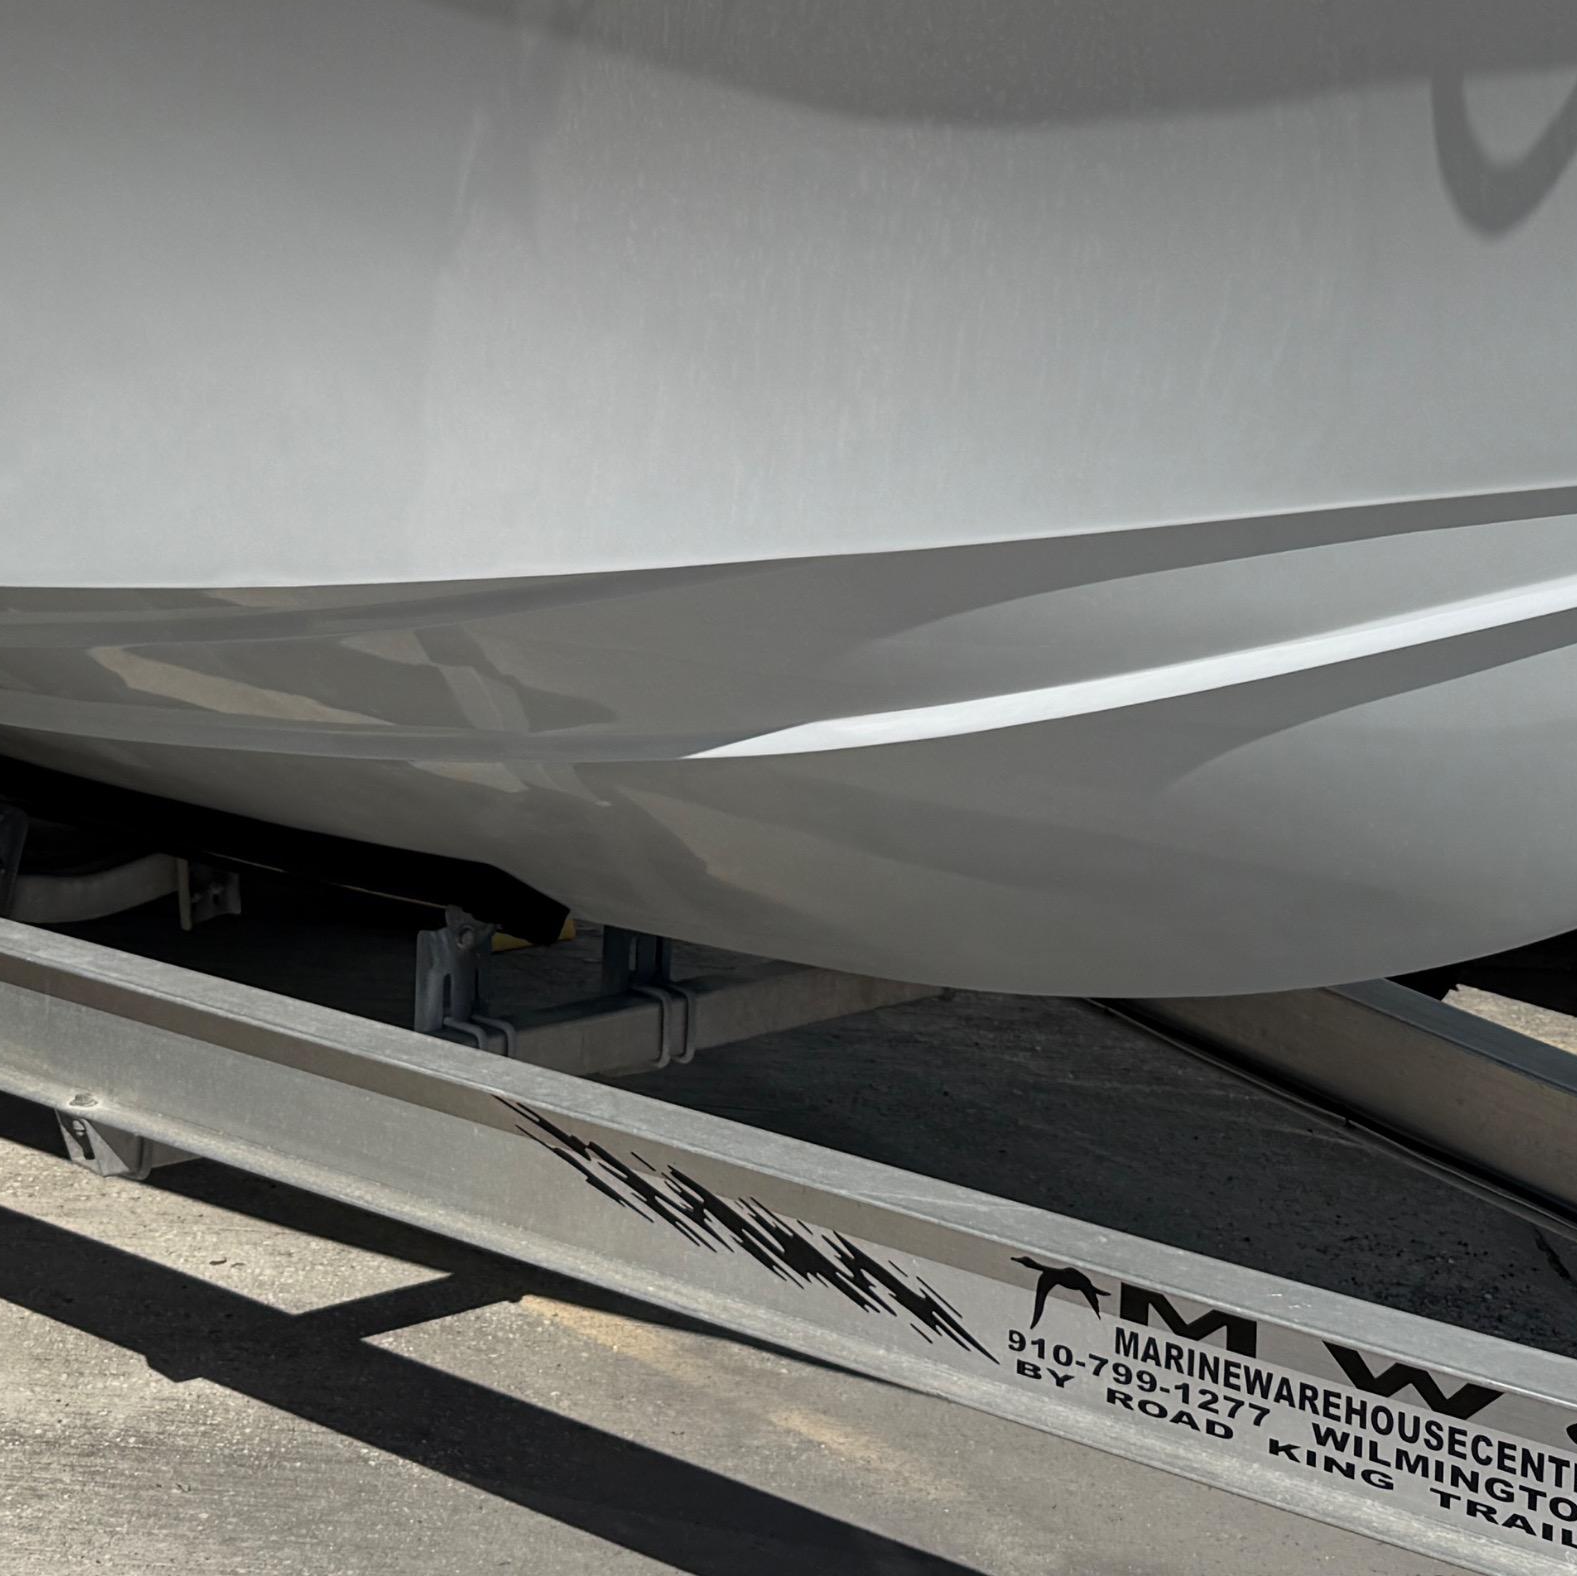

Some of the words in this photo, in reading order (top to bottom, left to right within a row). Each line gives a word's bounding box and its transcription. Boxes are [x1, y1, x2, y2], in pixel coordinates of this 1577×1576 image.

[1007, 1329, 1271, 1428] 910-799-1277
[1015, 1359, 1075, 1390] BY
[1106, 1386, 1234, 1441] ROAD
[1268, 1437, 1395, 1491] KING
